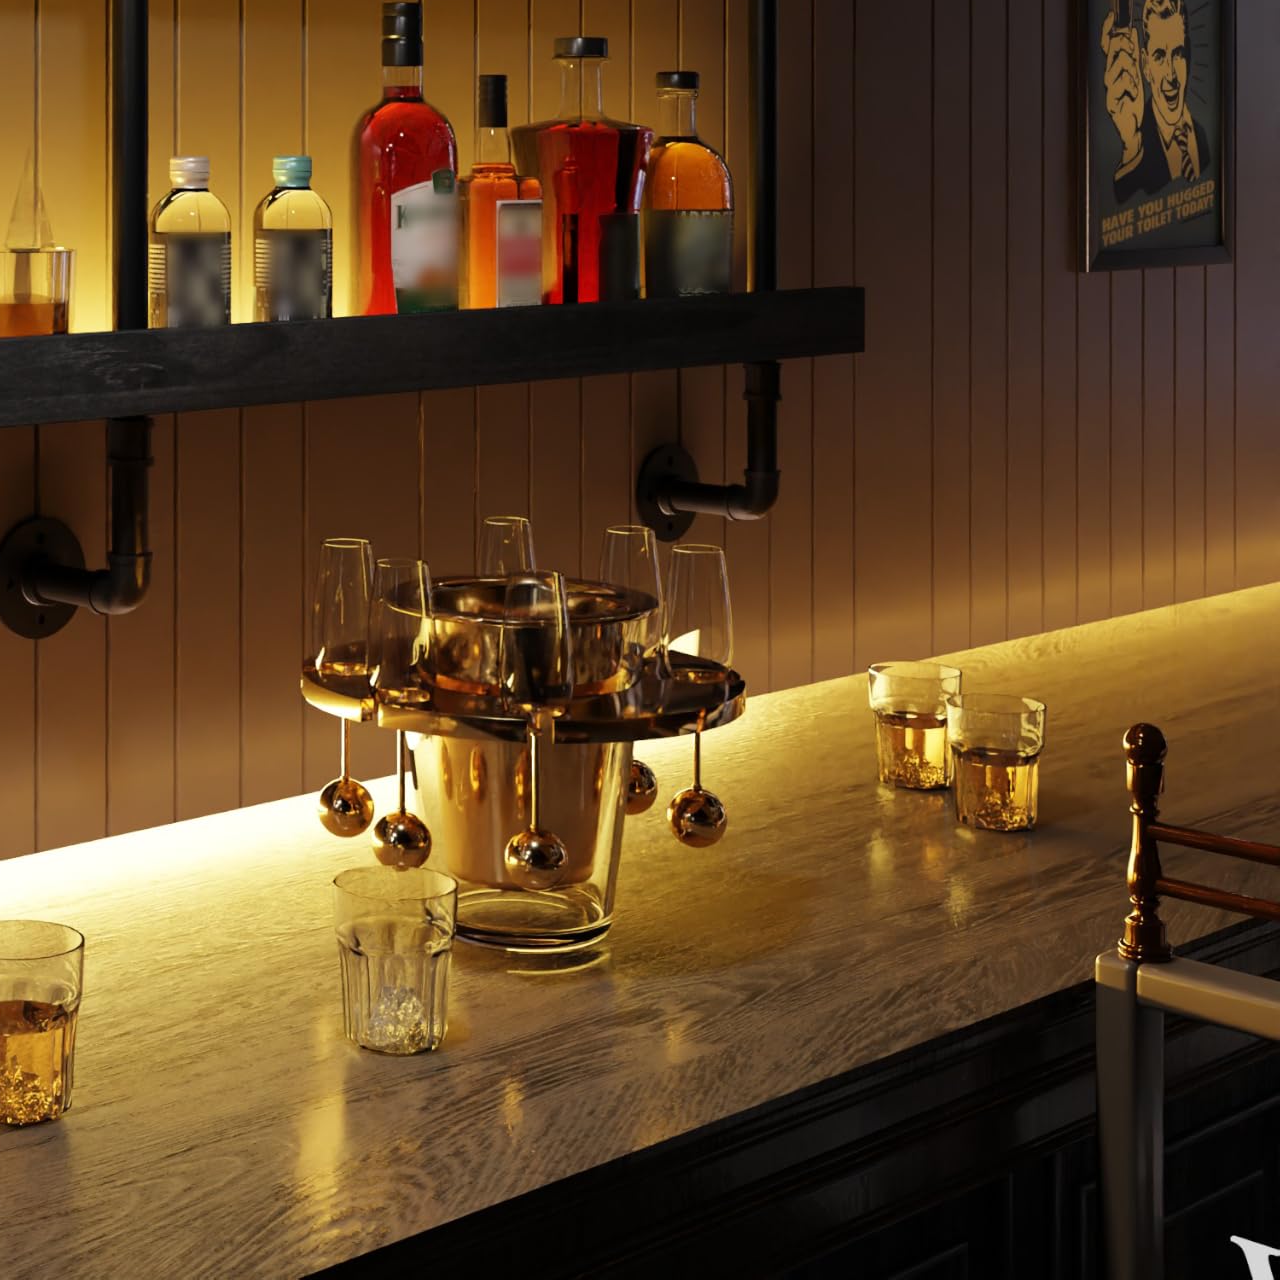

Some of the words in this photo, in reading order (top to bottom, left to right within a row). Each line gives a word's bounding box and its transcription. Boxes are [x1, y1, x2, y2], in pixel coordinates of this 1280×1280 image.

[1102, 208, 1134, 233] HAVE
[1138, 198, 1163, 218] YOU
[1167, 180, 1216, 208] HUGGED
[1103, 223, 1133, 247] YOUR
[1137, 209, 1172, 234] TOILET
